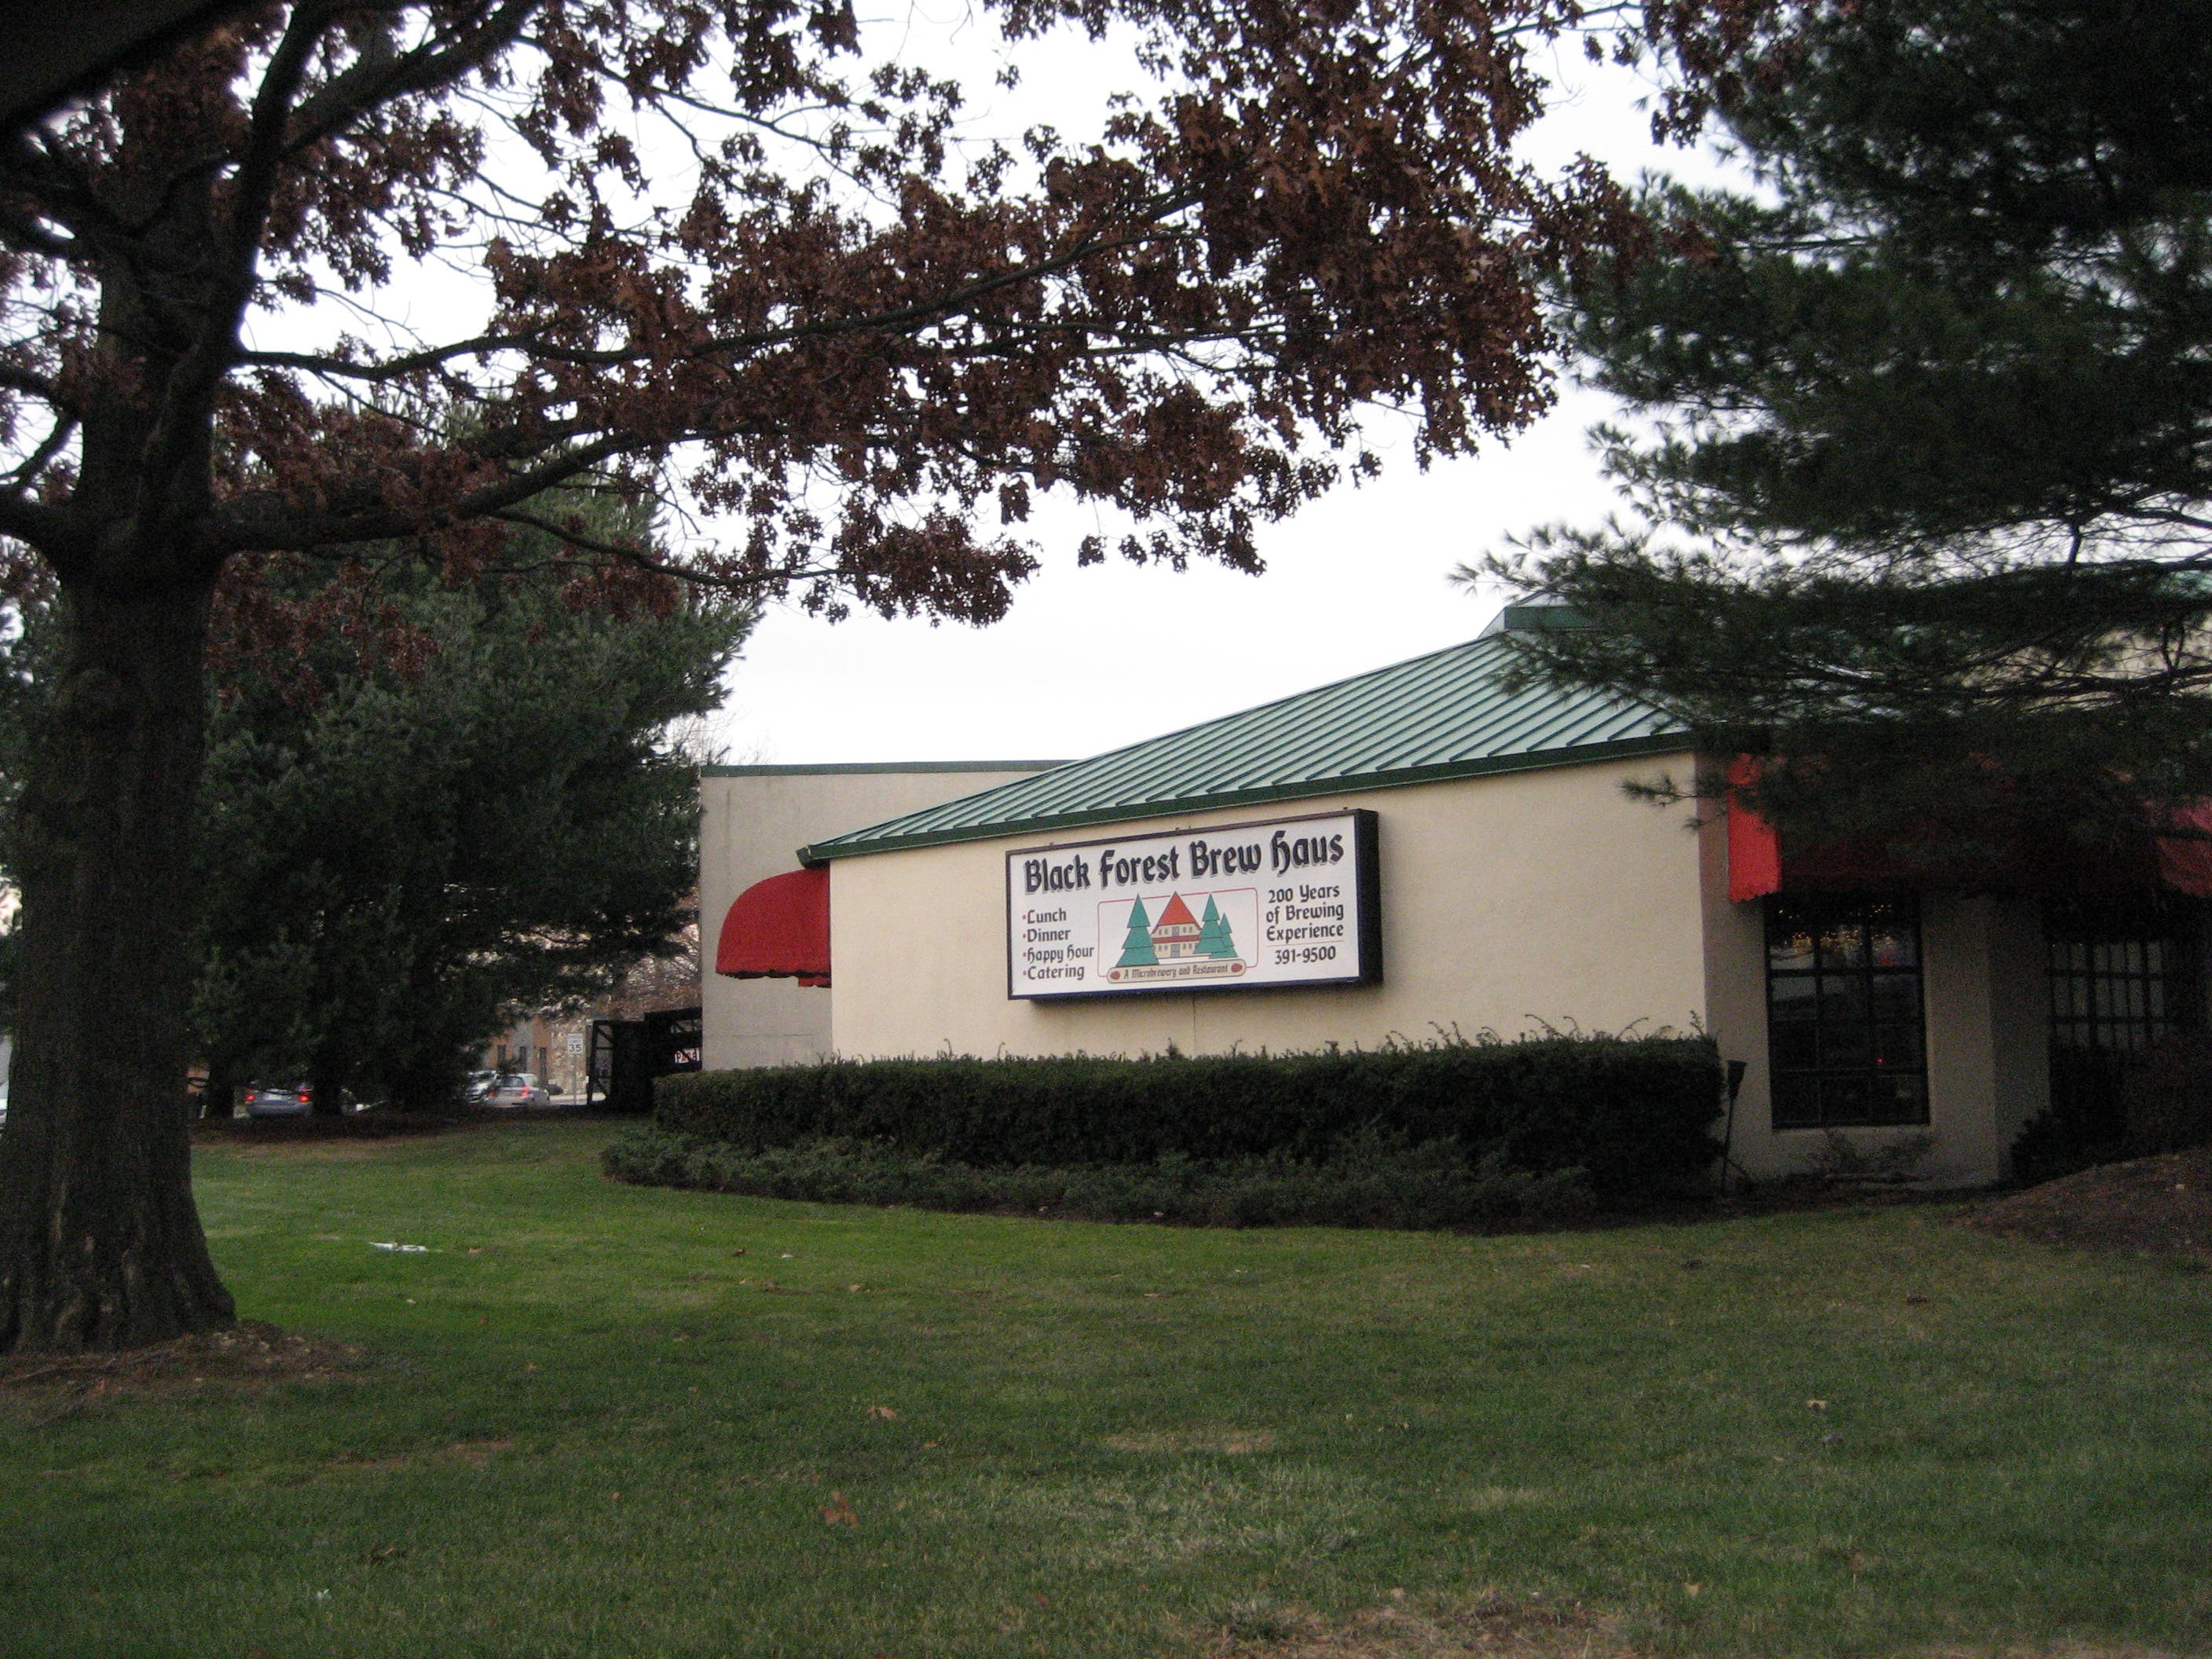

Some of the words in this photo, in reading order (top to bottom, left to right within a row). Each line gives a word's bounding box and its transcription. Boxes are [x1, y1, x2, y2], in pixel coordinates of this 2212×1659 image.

[1024, 854, 1091, 895] Black
[1100, 845, 1180, 890] Forest
[1189, 840, 1262, 879] Brew
[1271, 830, 1344, 877] Haus
[1268, 888, 1294, 903] 200
[1298, 884, 1340, 903] Years
[1027, 907, 1067, 924] Lunch
[1265, 906, 1280, 925] of
[1285, 901, 1344, 921] Brewing
[1027, 928, 1071, 943] Dinner
[1266, 922, 1344, 944] Experience
[1027, 947, 1064, 965] Happy
[1067, 944, 1094, 961] Hour
[1274, 945, 1337, 965] 391-9500
[1027, 963, 1085, 980] Catering
[1124, 969, 1130, 979] A
[1131, 967, 1177, 978] Microbrewery
[1179, 966, 1191, 975] and
[1192, 964, 1229, 975] Restaurant
[569, 1044, 582, 1053] 35
